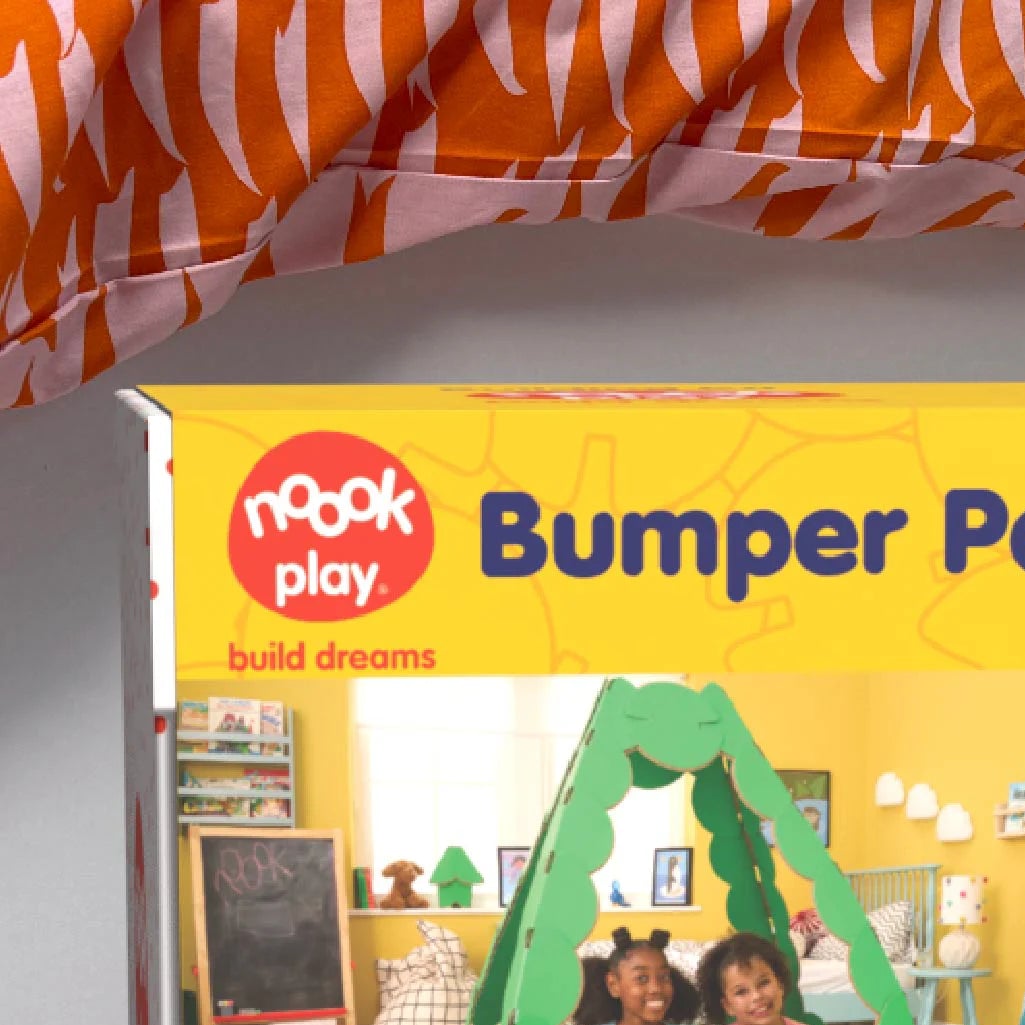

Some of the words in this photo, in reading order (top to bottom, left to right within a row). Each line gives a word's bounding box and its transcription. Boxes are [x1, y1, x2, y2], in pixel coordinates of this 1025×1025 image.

[480, 490, 909, 603] Bumper
[228, 641, 305, 672] build
[316, 641, 436, 670] dreams
